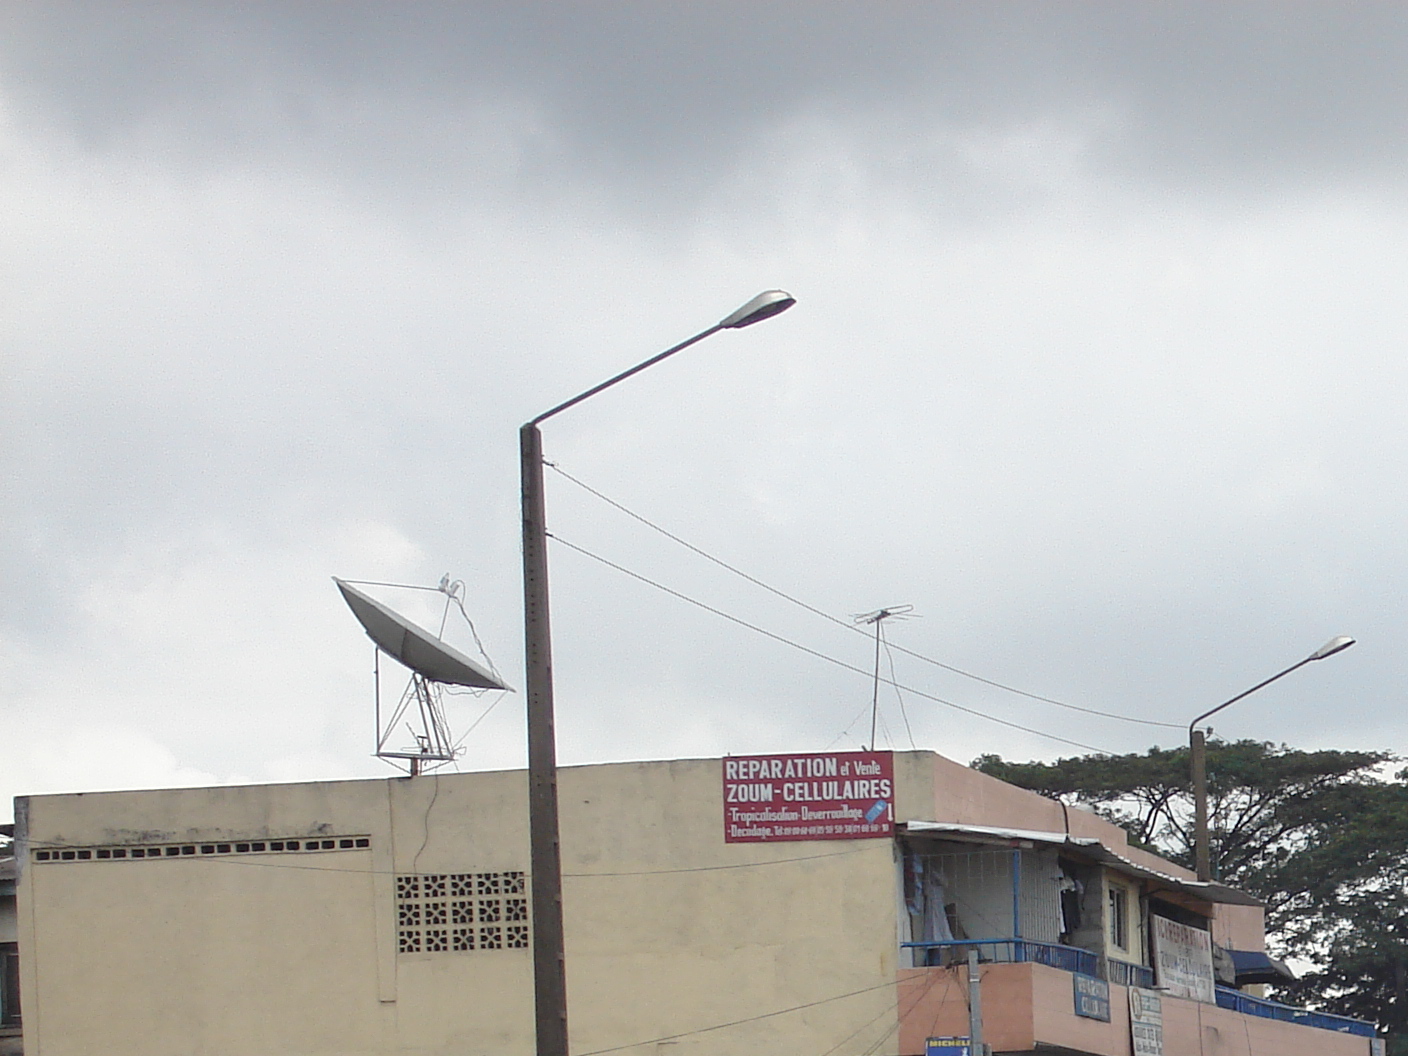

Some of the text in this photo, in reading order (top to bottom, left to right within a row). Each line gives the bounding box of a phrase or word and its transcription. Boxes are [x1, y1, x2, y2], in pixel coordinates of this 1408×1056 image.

[726, 757, 837, 780] REPARATION
[727, 778, 891, 803] ZOUM-CELLULAIRES
[929, 1039, 971, 1047] MICHELI
